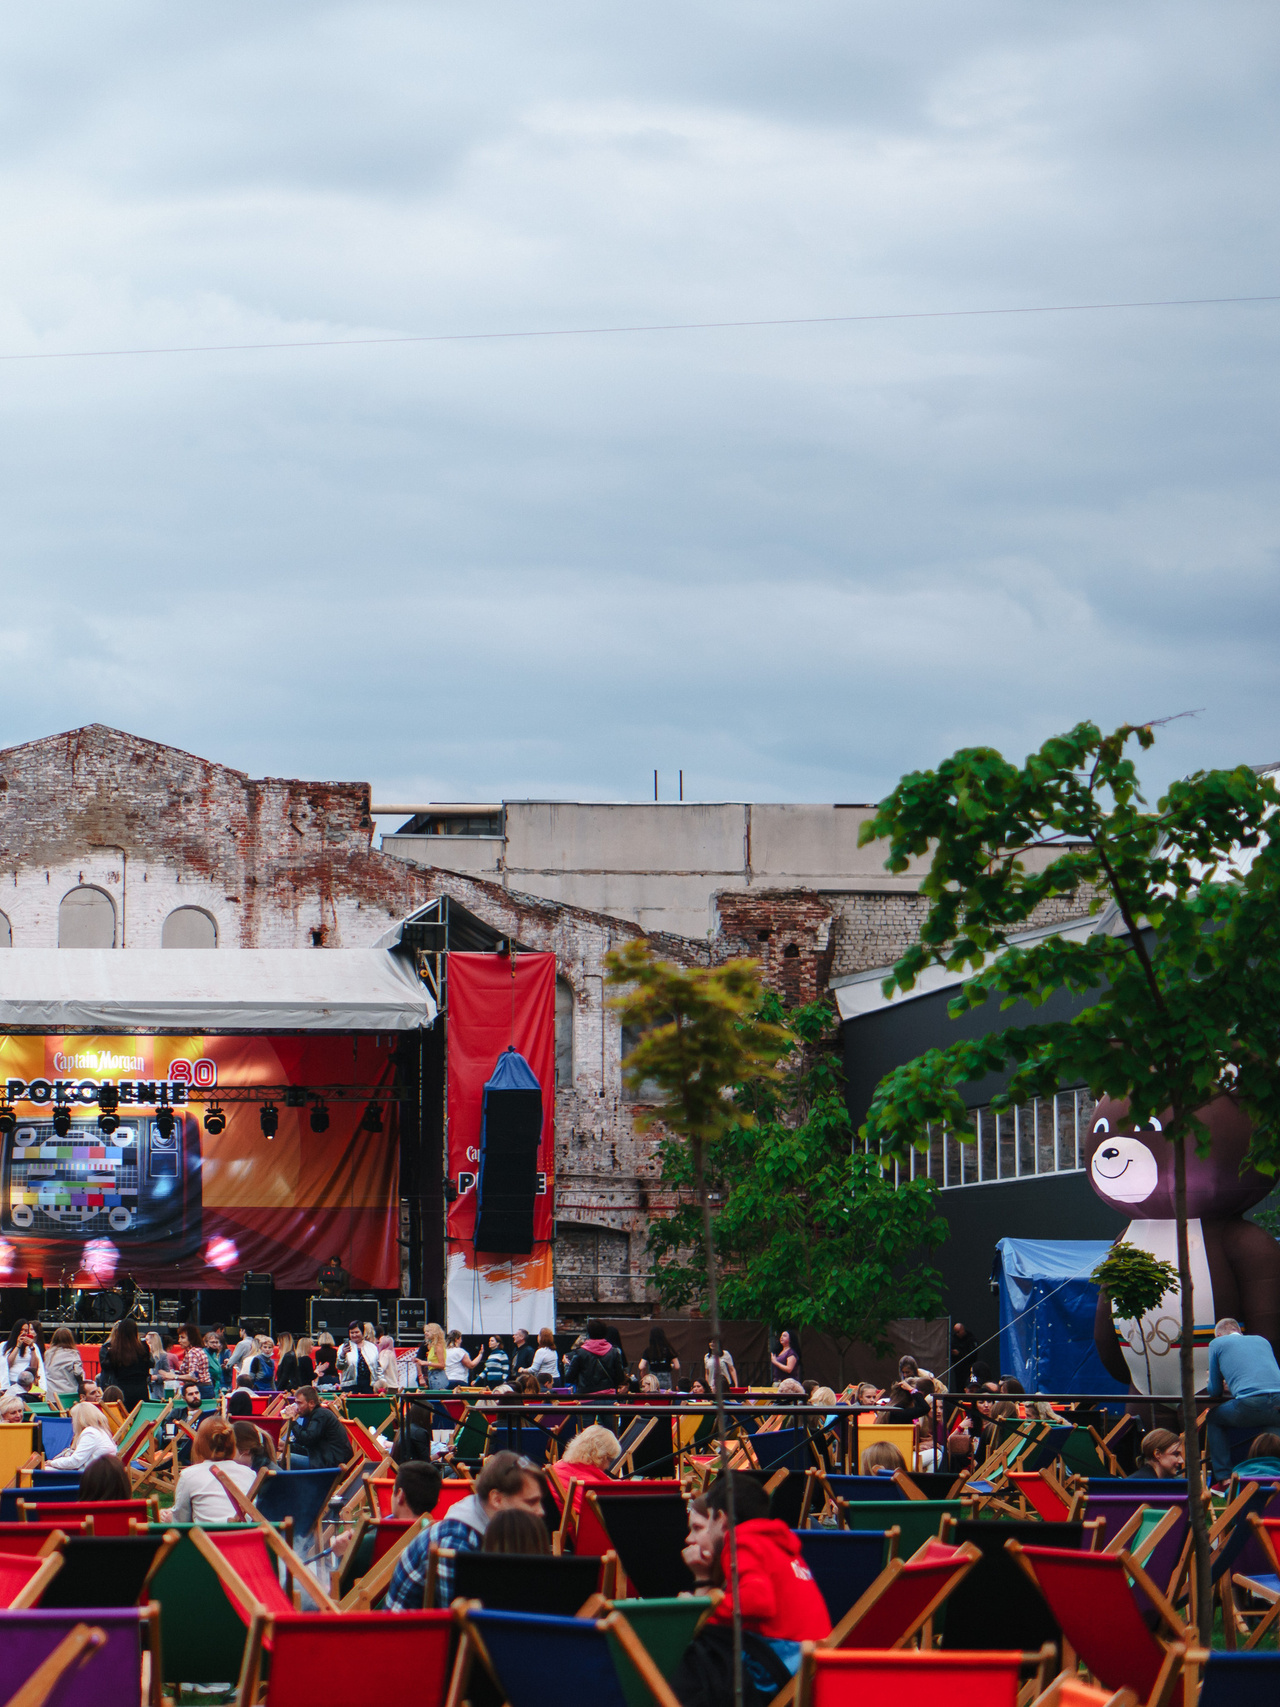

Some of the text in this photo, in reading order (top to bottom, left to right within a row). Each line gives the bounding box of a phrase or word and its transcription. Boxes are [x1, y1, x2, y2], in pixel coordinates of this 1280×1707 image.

[53, 1051, 145, 1073] Captain Morgan
[169, 1058, 217, 1087] 80
